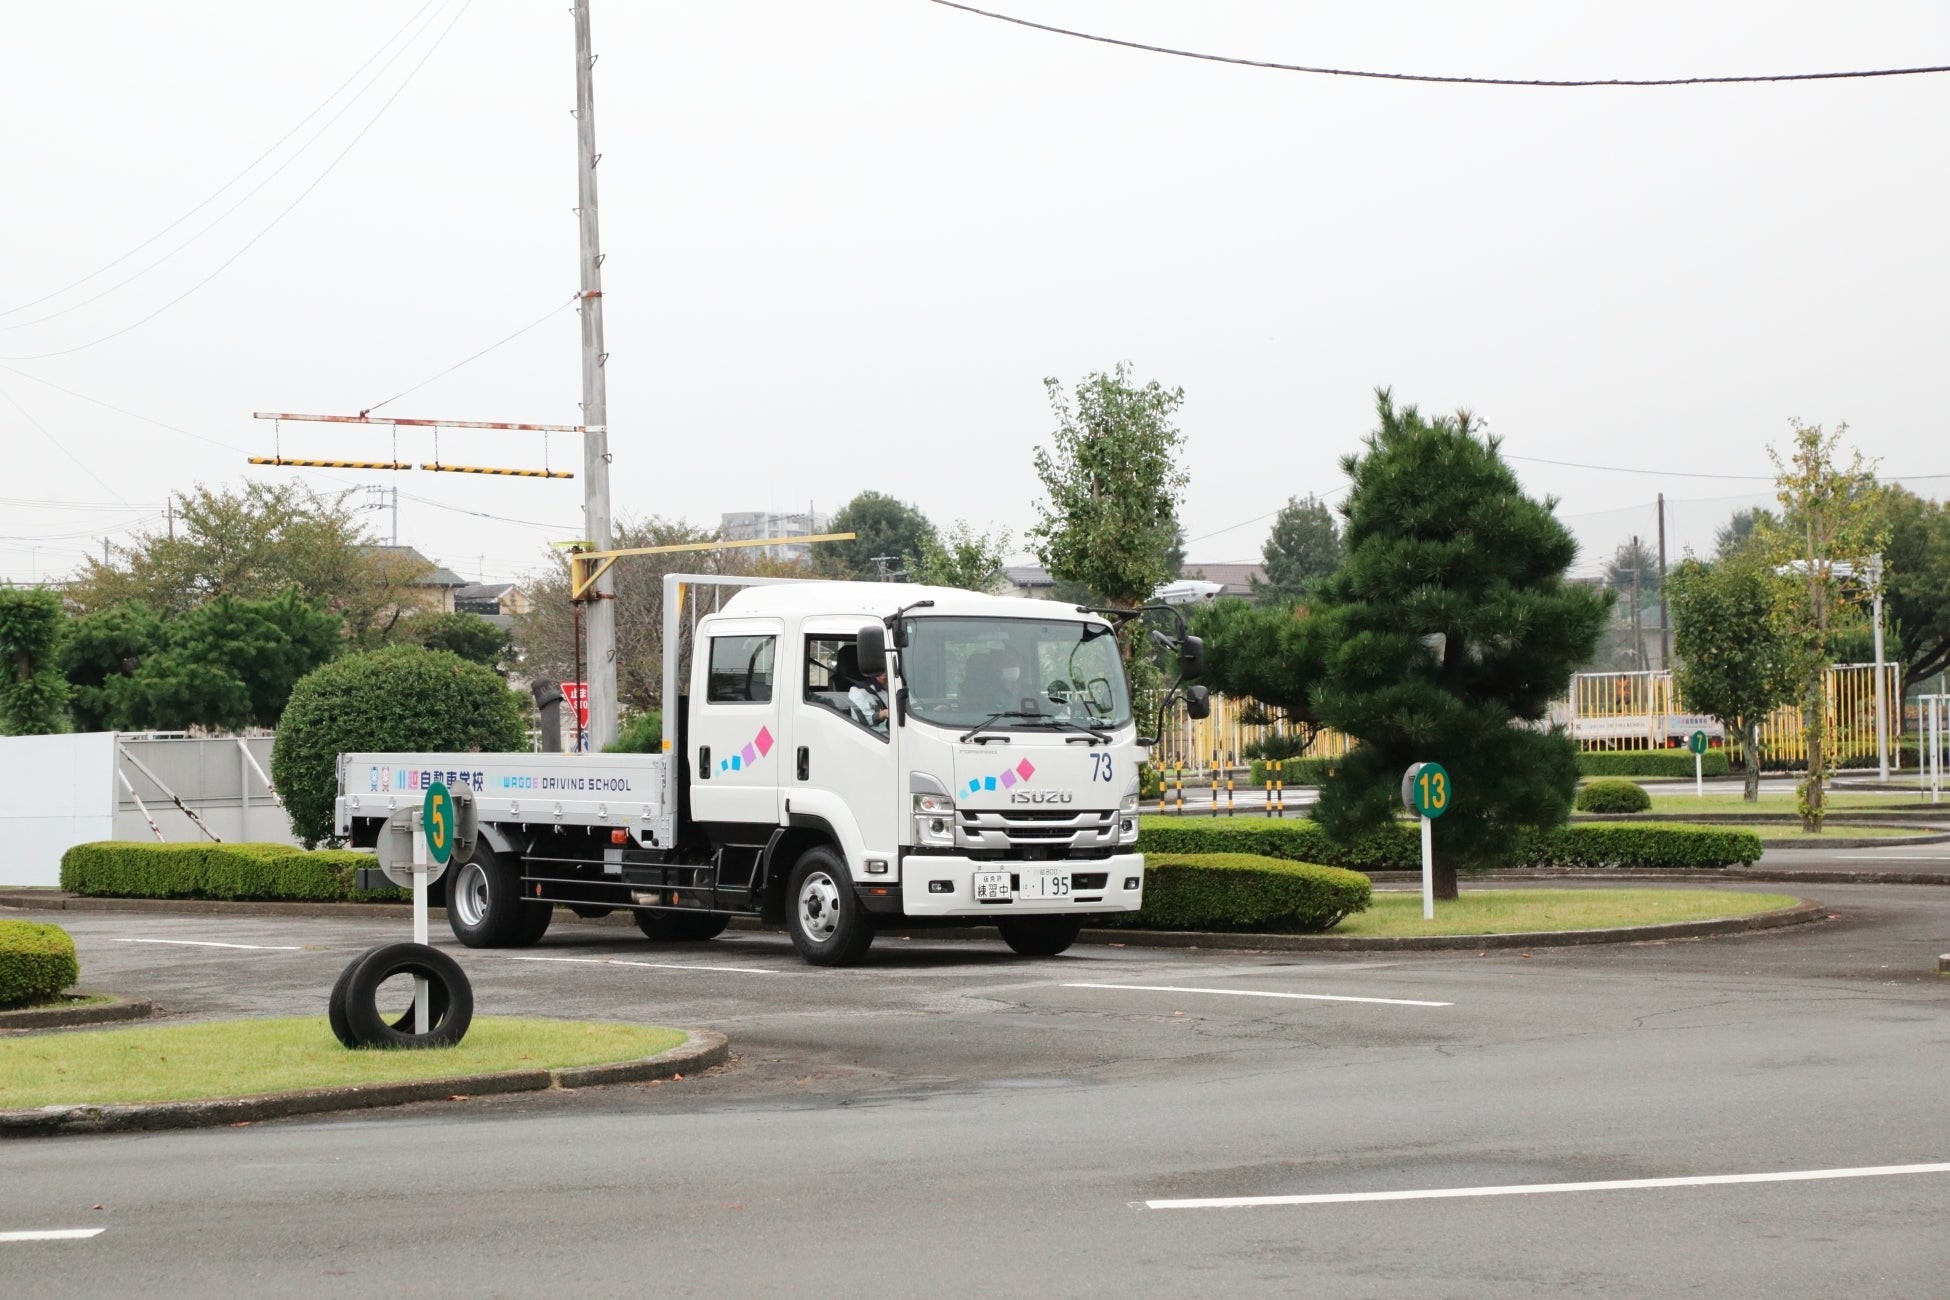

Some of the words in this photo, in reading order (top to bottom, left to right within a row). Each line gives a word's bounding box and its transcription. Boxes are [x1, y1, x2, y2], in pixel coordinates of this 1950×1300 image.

[570, 688, 588, 699] 止ま
[574, 700, 588, 710] STO
[1696, 734, 1703, 750] 7
[1090, 752, 1113, 782] 73
[489, 776, 539, 790] WAGOE
[542, 777, 585, 791] DRIVING
[588, 778, 632, 792] SCHOOL
[1420, 772, 1446, 809] 13
[1010, 788, 1072, 804] ISUZU
[432, 794, 445, 849] 5
[977, 883, 1009, 898] 練習中
